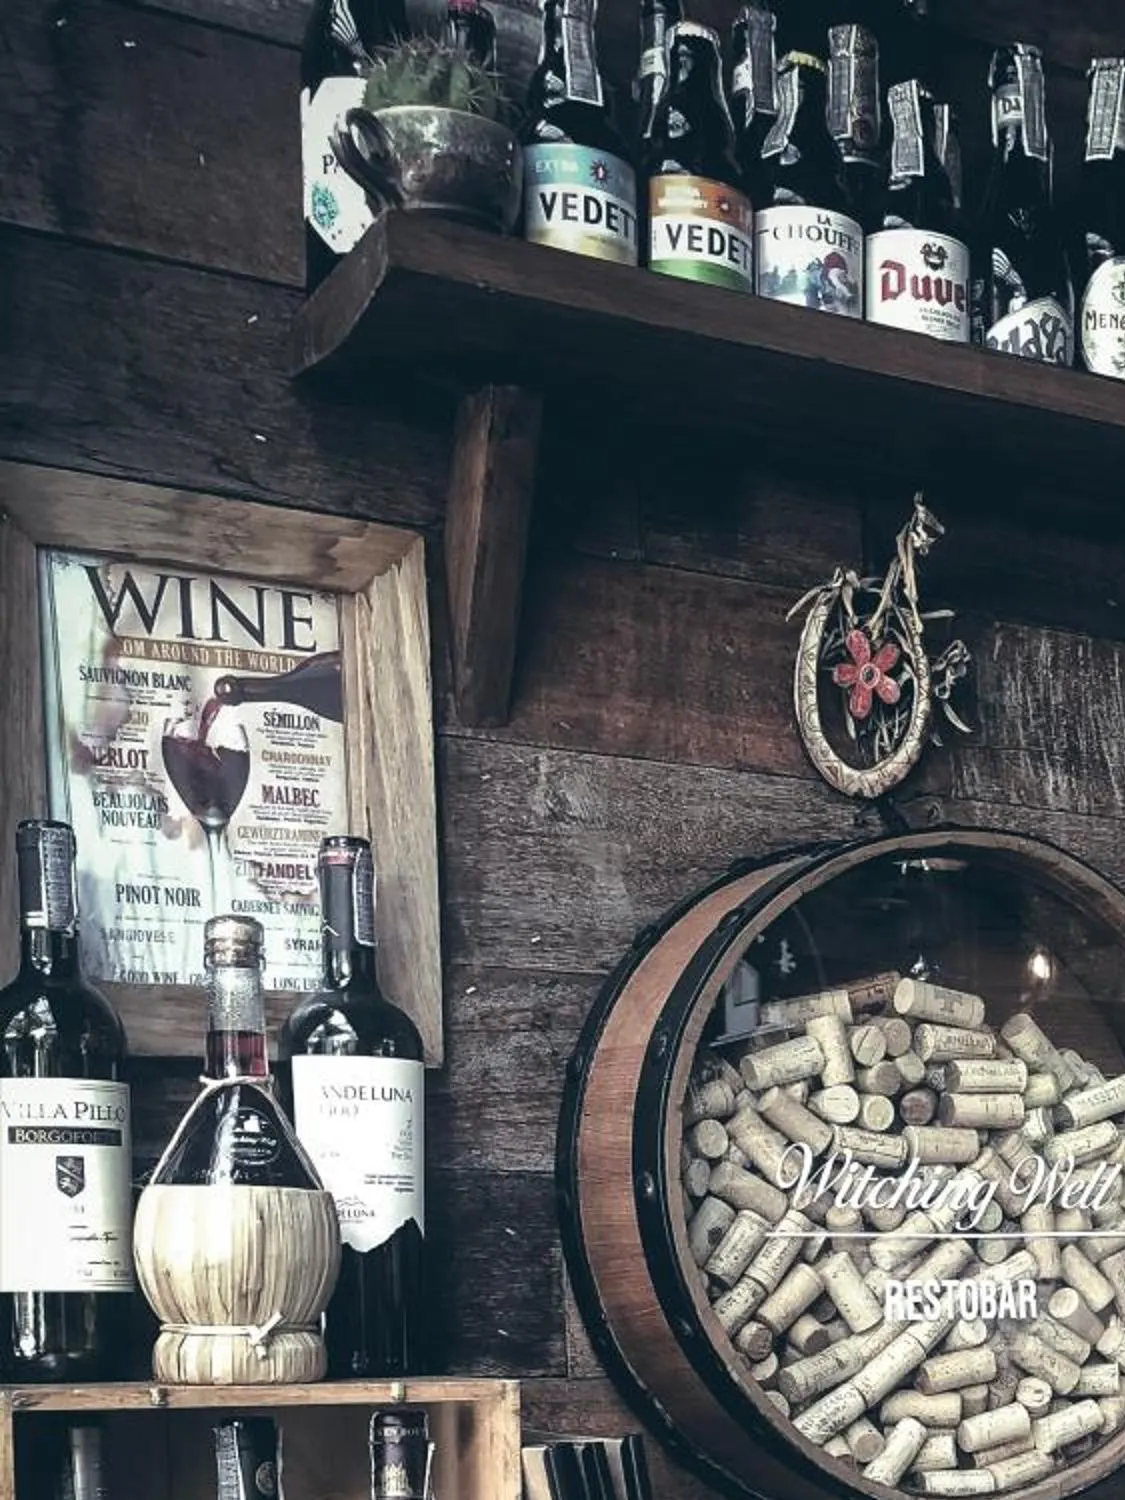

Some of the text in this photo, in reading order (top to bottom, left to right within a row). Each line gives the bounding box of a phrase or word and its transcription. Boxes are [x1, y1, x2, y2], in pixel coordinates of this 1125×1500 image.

[816, 213, 833, 226] LA
[665, 223, 751, 271] VEDET
[80, 564, 317, 652] WINE
[151, 641, 209, 665] AROUND
[215, 649, 242, 668] THE
[248, 652, 297, 673] WORLD
[79, 665, 193, 693] SAUVIGNON BLANC
[93, 789, 169, 815] BEAUJOLAIS
[261, 784, 321, 808] MALBEC
[101, 808, 163, 830] NOUVEAU
[115, 883, 202, 908] PINOT NOIR
[284, 902, 321, 918] SAUVIG
[320, 1085, 414, 1104] ANDELUNA
[74, 1101, 127, 1123] PILLO
[15, 1127, 119, 1146] BORGOFO
[775, 1141, 1124, 1232] Witching Well
[883, 1278, 1039, 1321] RESTOBAR
